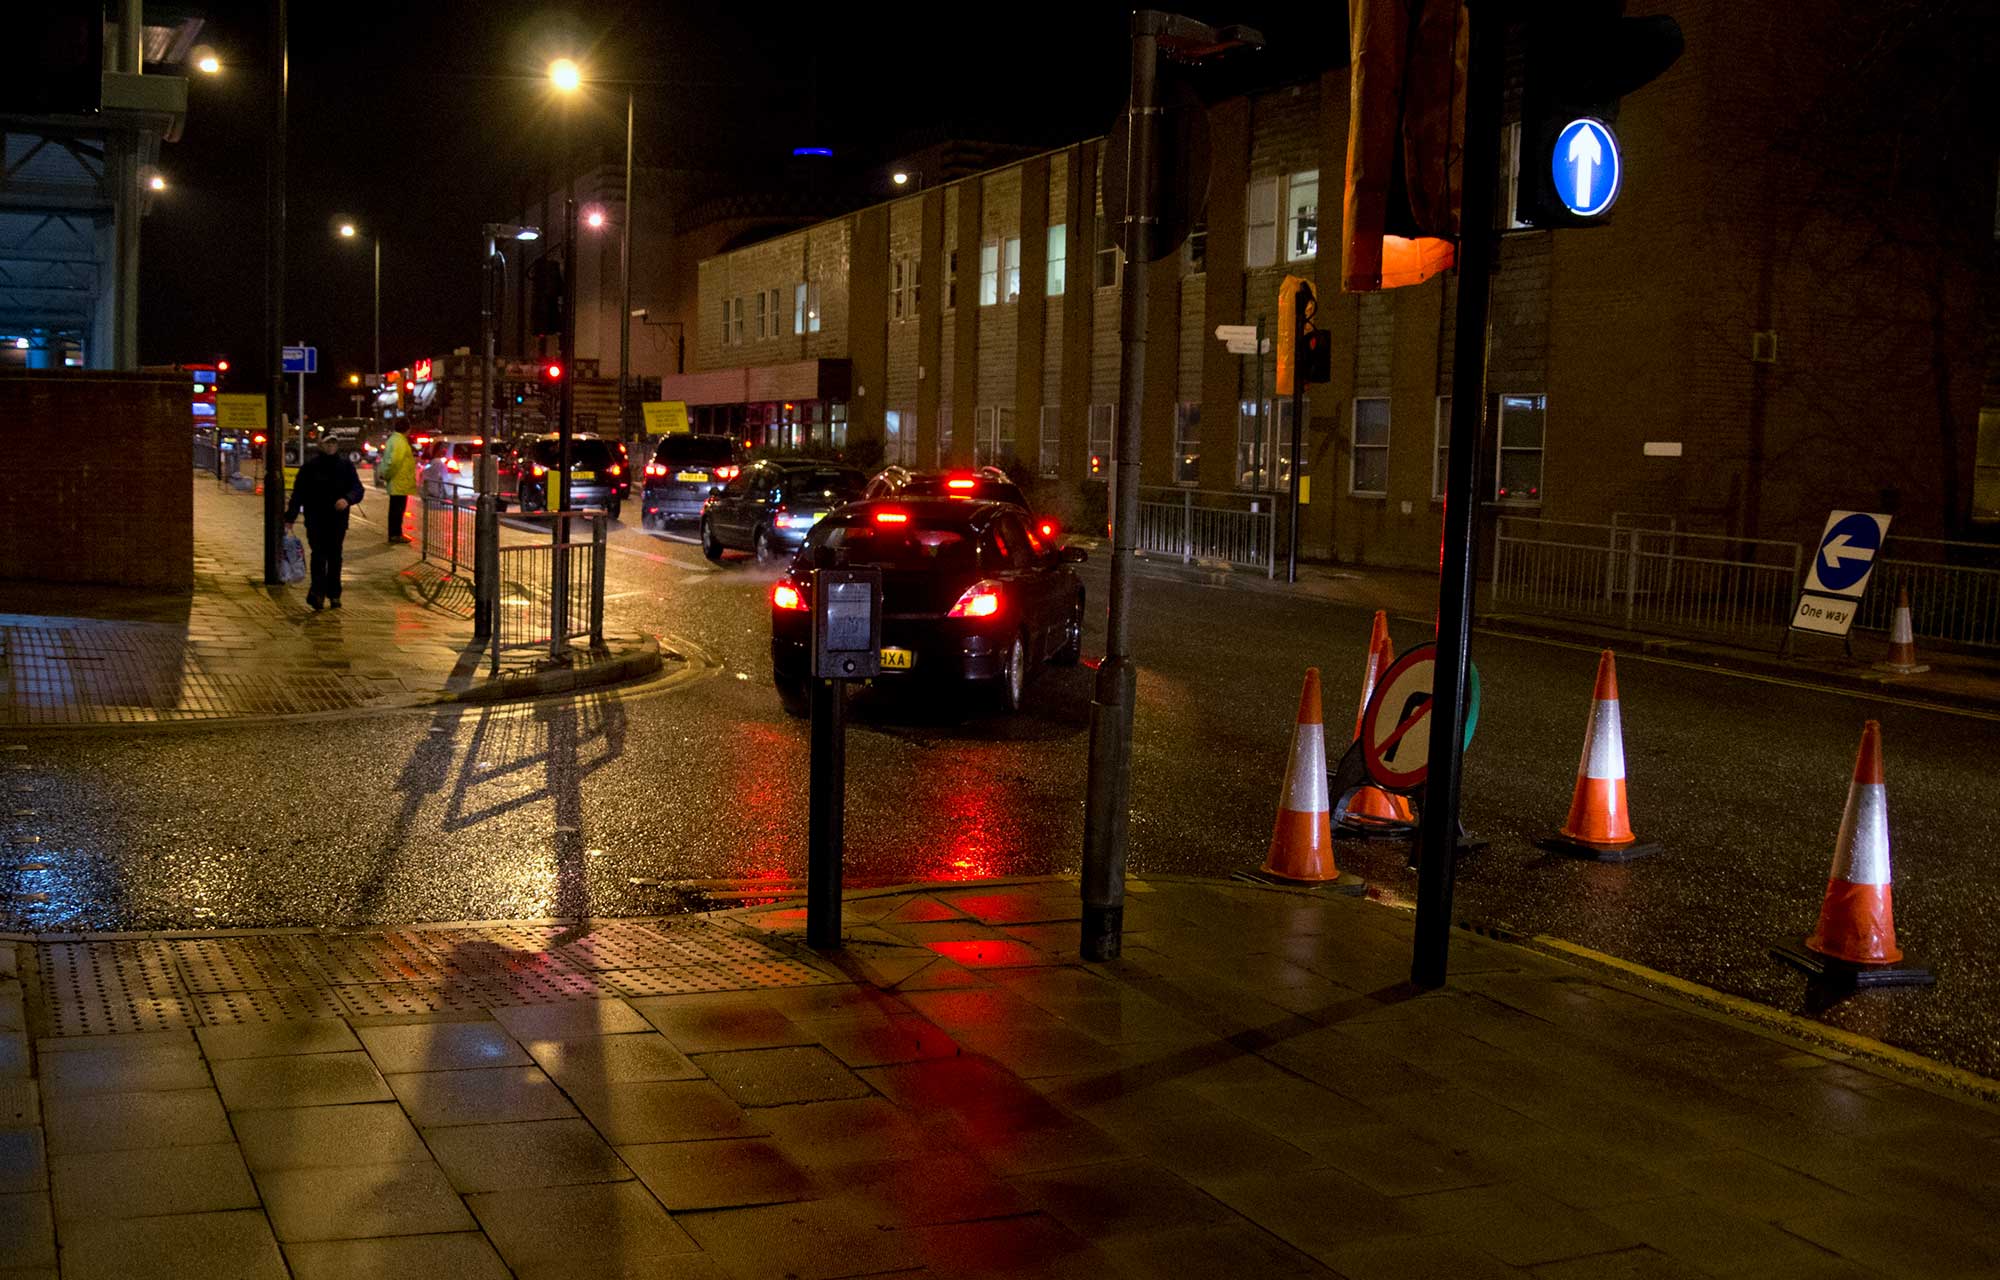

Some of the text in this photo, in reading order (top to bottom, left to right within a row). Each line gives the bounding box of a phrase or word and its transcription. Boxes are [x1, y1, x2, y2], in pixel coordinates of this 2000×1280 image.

[1800, 604, 1849, 625] One way
[879, 652, 905, 666] HXA
